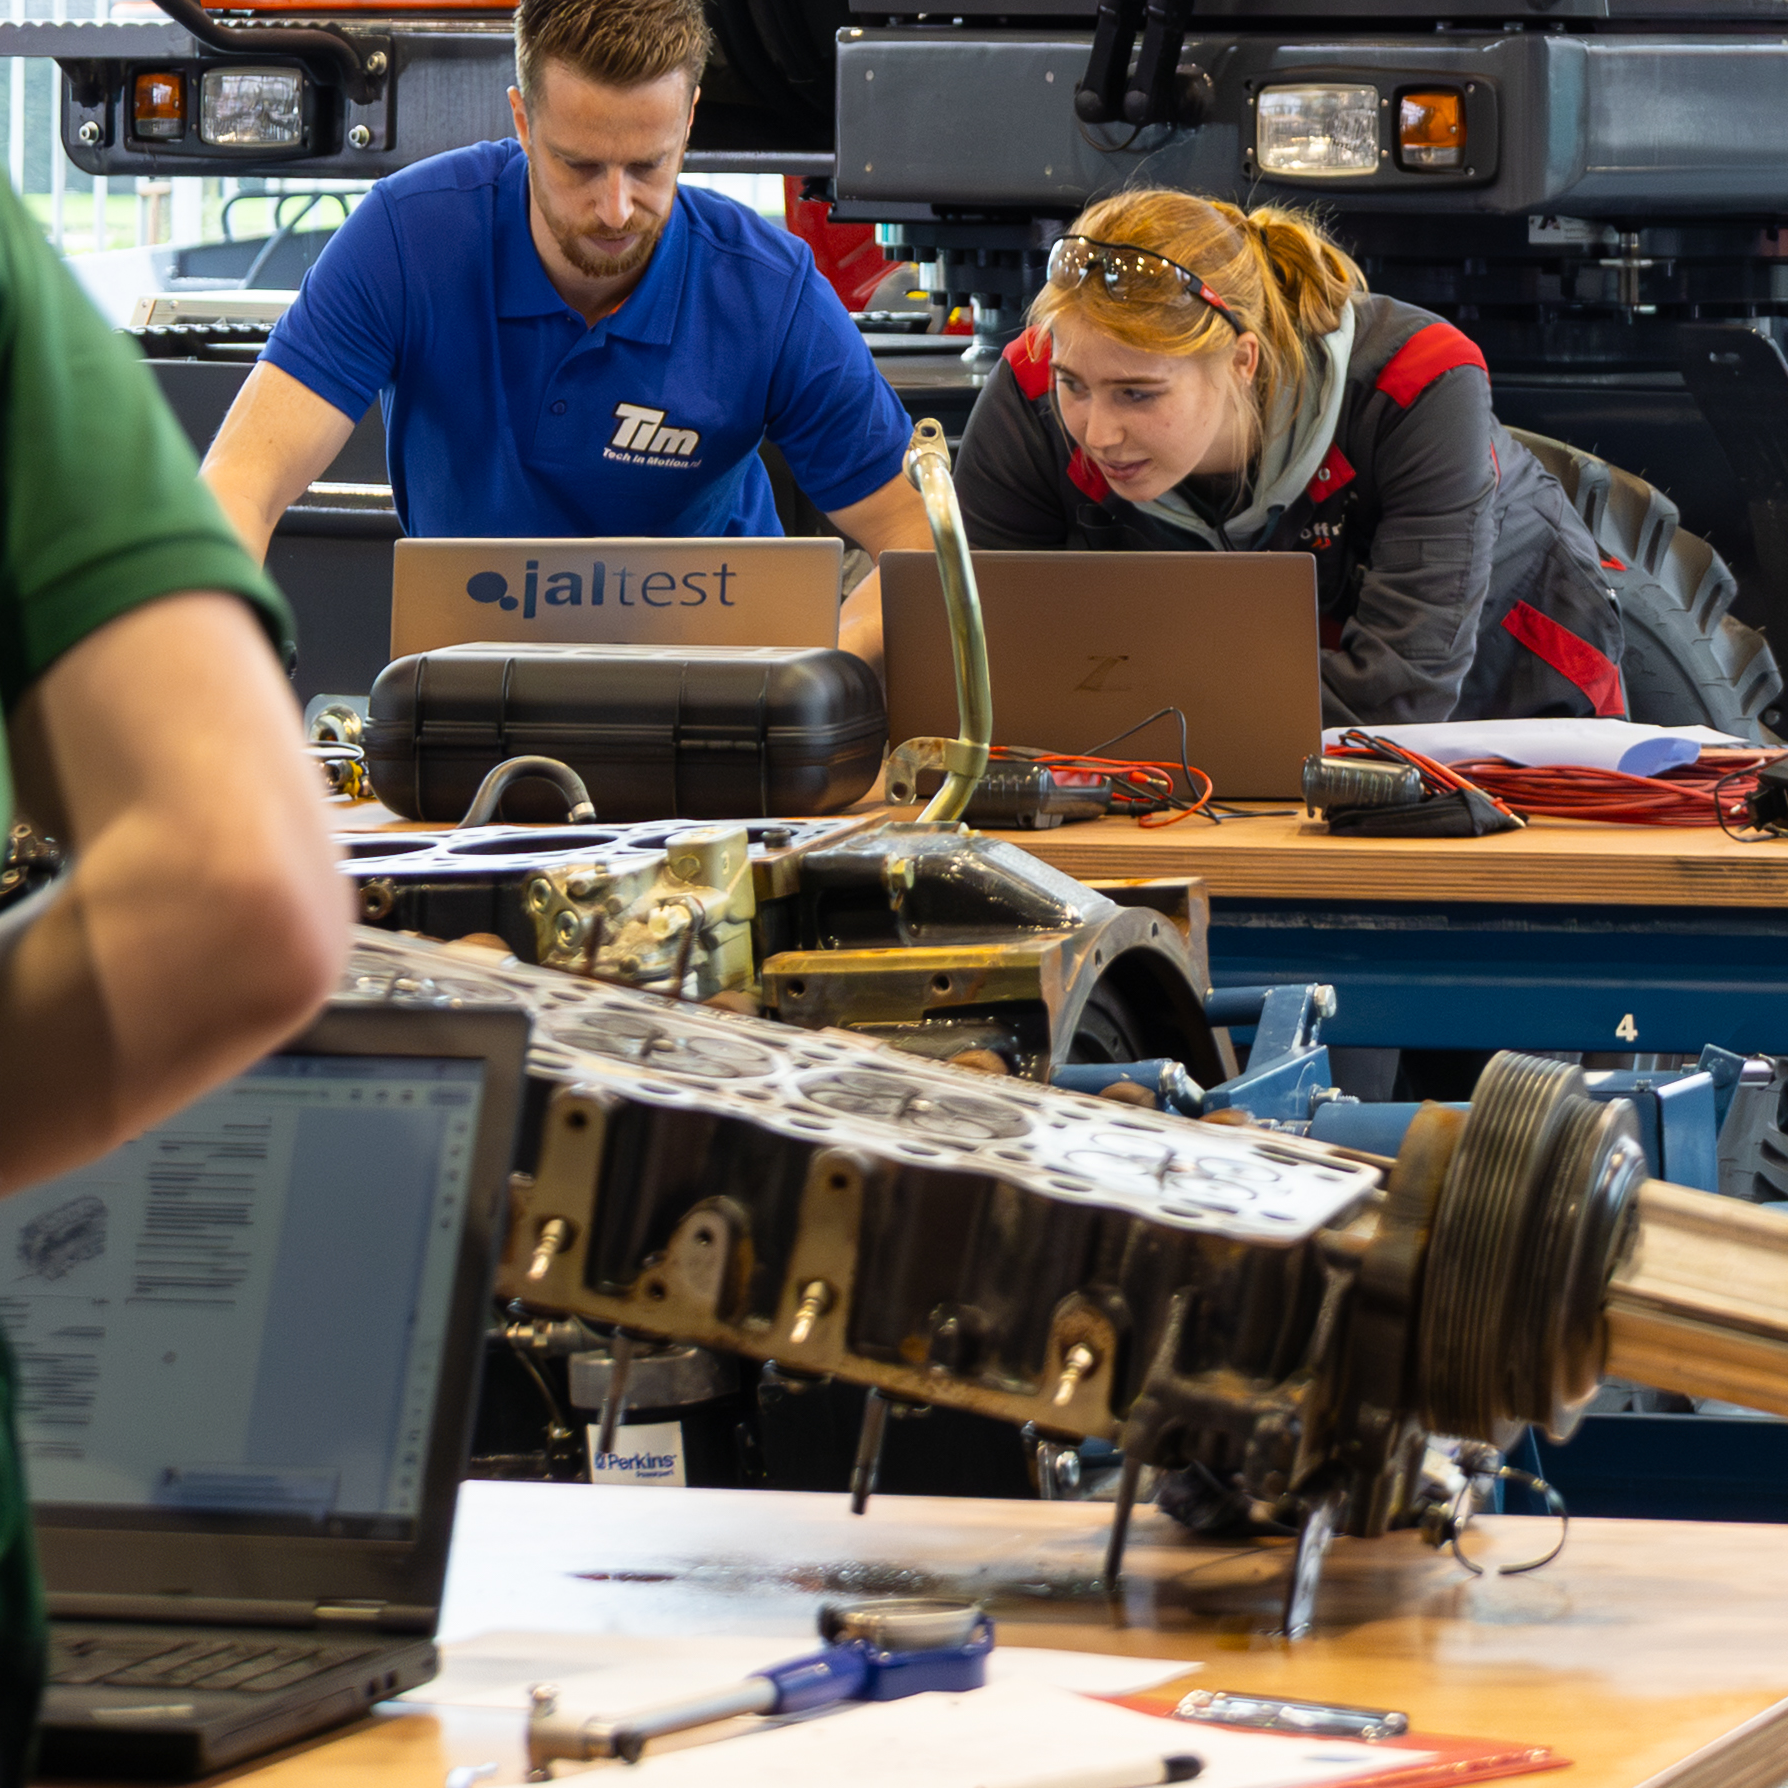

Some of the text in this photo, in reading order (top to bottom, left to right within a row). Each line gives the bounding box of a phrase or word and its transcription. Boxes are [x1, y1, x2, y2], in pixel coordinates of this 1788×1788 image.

[602, 447, 632, 463] Tech
[523, 559, 738, 620] jaltest
[1615, 1013, 1639, 1042] 4
[607, 1452, 675, 1470] Perkins
